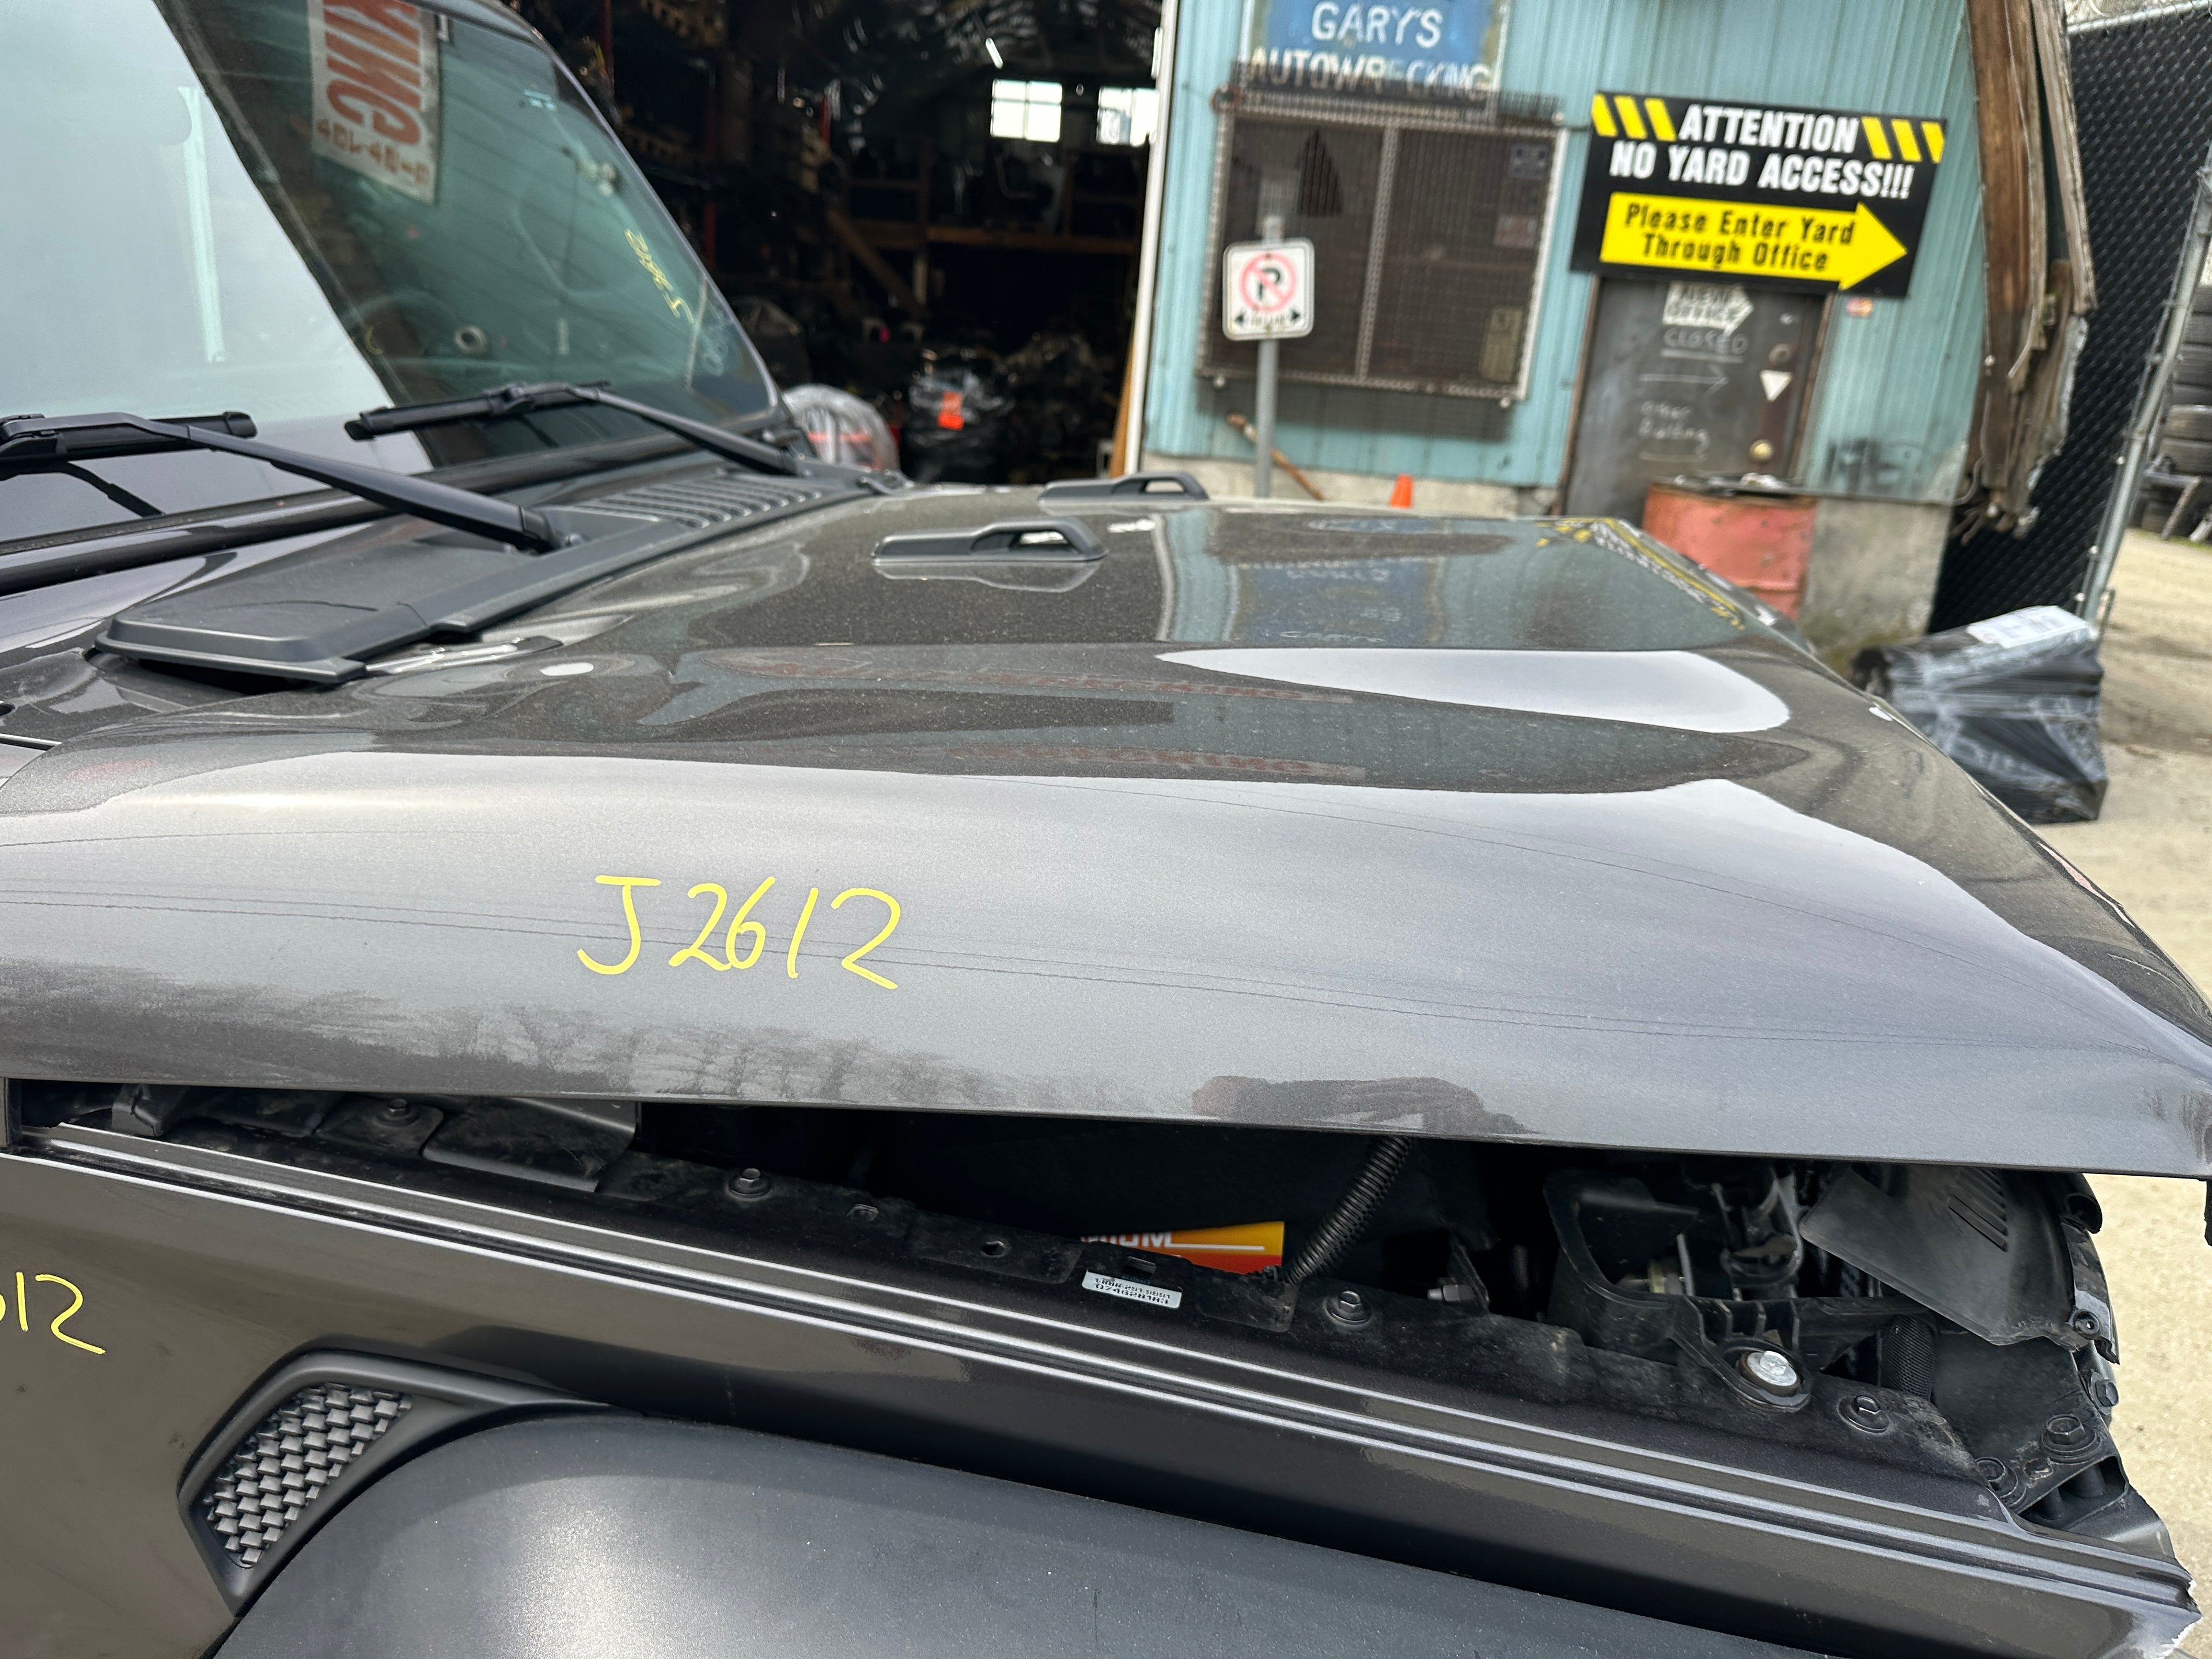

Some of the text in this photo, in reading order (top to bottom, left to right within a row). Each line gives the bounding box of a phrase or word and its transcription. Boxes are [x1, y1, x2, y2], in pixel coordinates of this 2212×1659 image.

[1679, 104, 1861, 154] ATTENTION
[1609, 139, 1915, 200] NO YARD ACCESS!!!
[1624, 202, 1856, 245] Please Enter Yard
[1642, 232, 1829, 272] Through Office
[577, 875, 900, 989] J2612
[0, 1272, 106, 1355] 12
